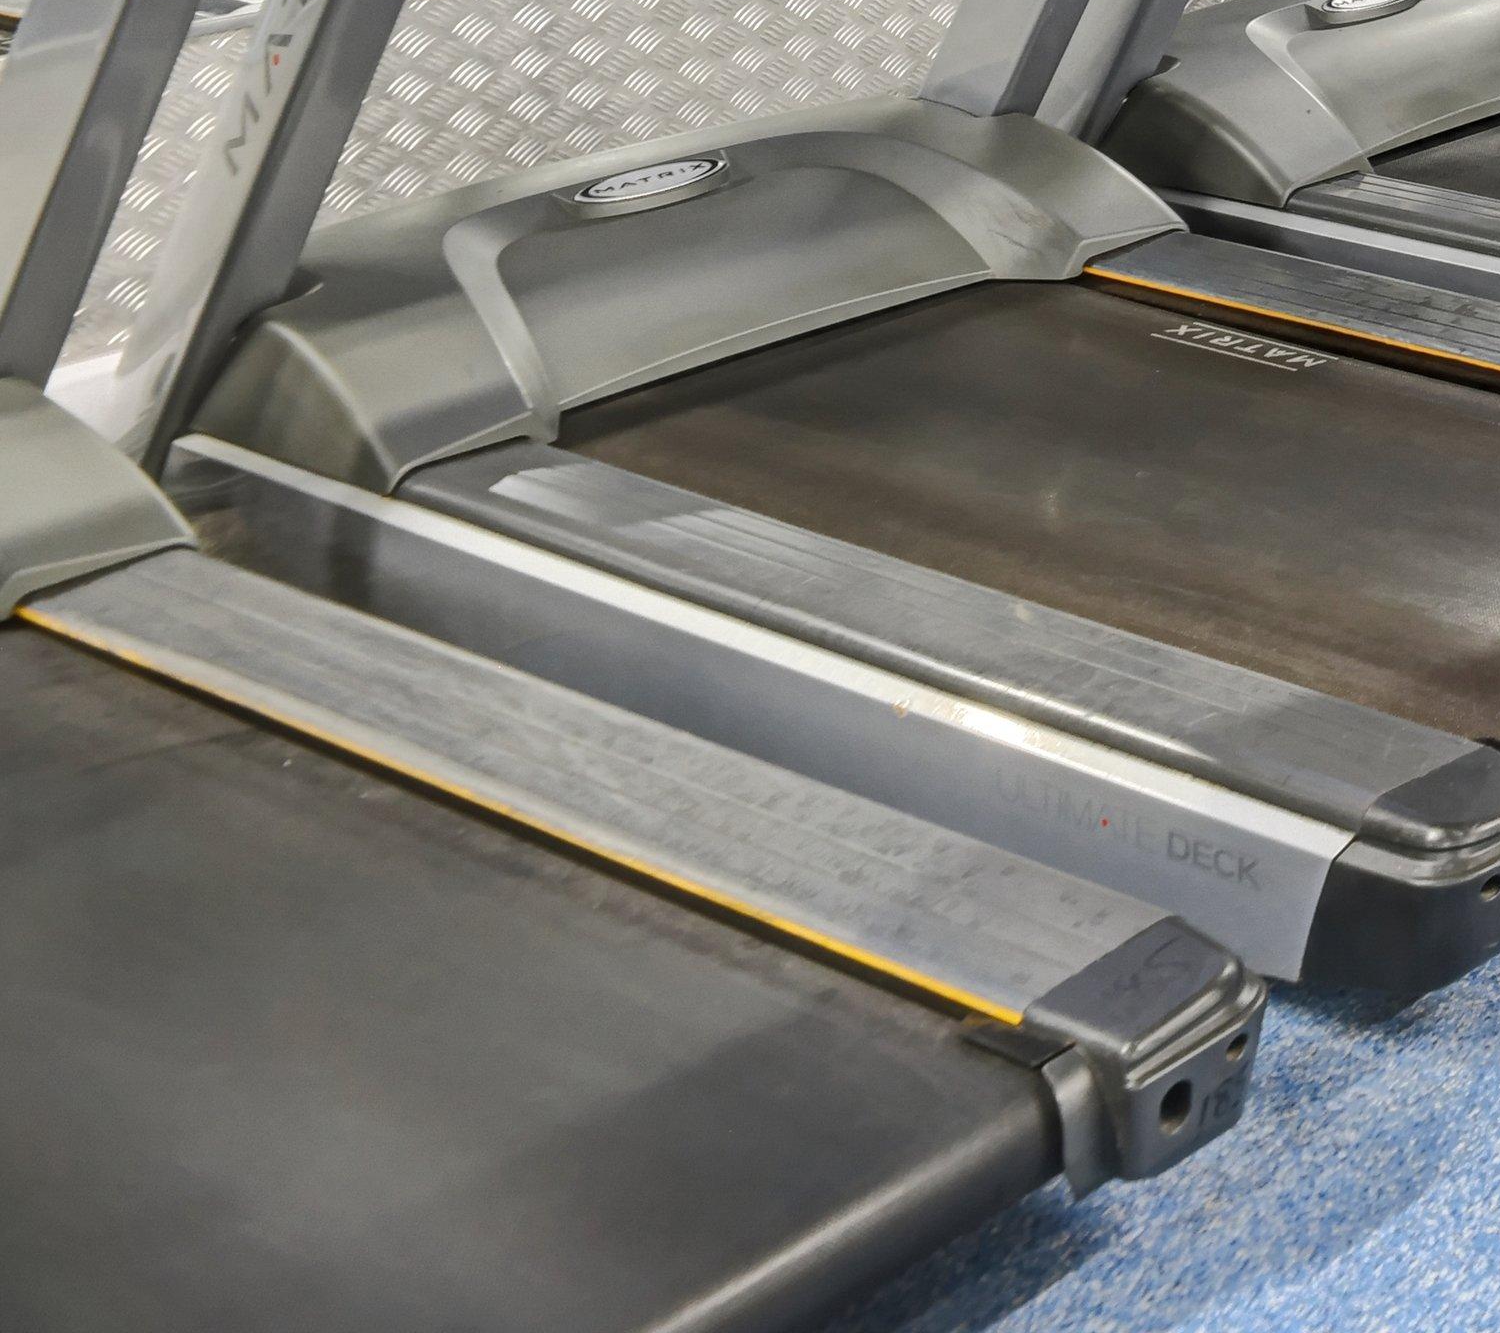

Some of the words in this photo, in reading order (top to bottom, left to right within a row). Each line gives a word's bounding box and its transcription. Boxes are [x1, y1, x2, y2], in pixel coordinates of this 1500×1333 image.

[594, 161, 707, 194] MATRIX
[1168, 324, 1328, 369] MATRIX
[1167, 828, 1264, 891] DECK
